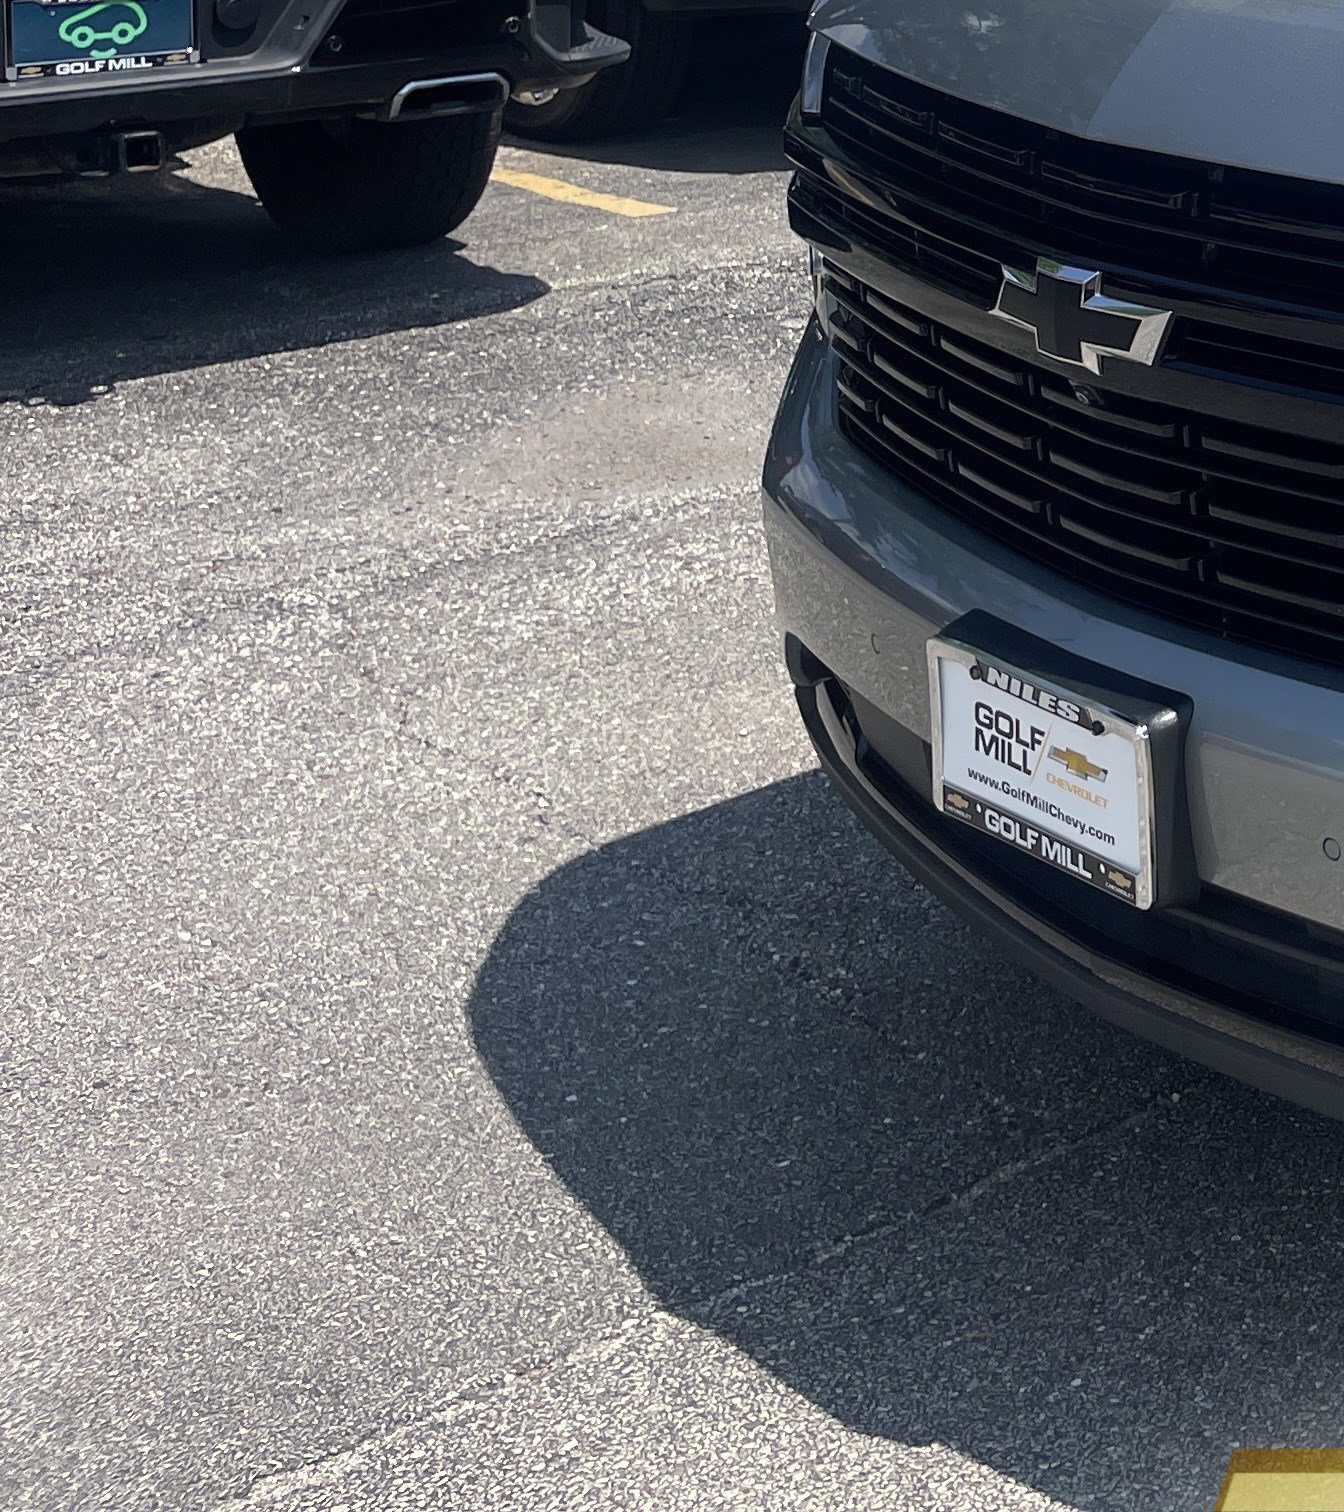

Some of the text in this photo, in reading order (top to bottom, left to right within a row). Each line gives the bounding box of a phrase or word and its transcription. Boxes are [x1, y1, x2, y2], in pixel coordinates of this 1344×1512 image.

[55, 59, 106, 76] GOLF
[107, 56, 153, 71] MILL
[986, 666, 1081, 723] NILES
[974, 700, 1046, 752] GOLF
[974, 726, 1033, 777] MILL
[967, 766, 1116, 846] www.GolfMillChevy.com
[1045, 771, 1110, 809] CHEVROLET
[983, 808, 1094, 880] GOLF MILL
